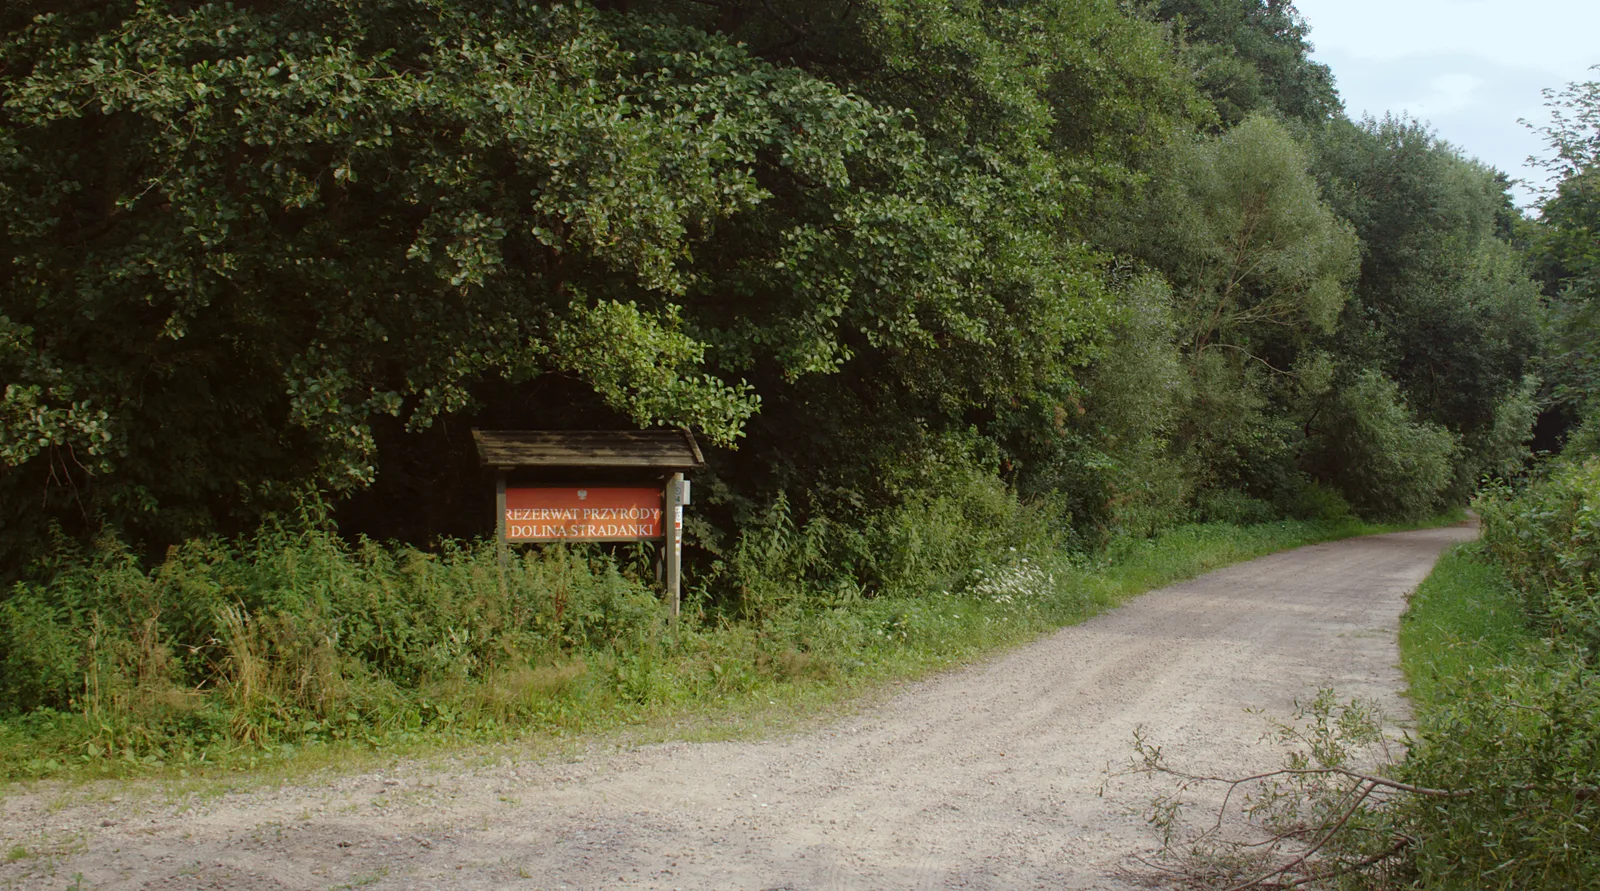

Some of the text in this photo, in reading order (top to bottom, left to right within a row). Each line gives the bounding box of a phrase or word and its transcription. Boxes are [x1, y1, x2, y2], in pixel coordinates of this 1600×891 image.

[505, 508, 660, 521] REZERWAT PRZYRODY
[511, 525, 653, 537] DOLINA STRADANKI
